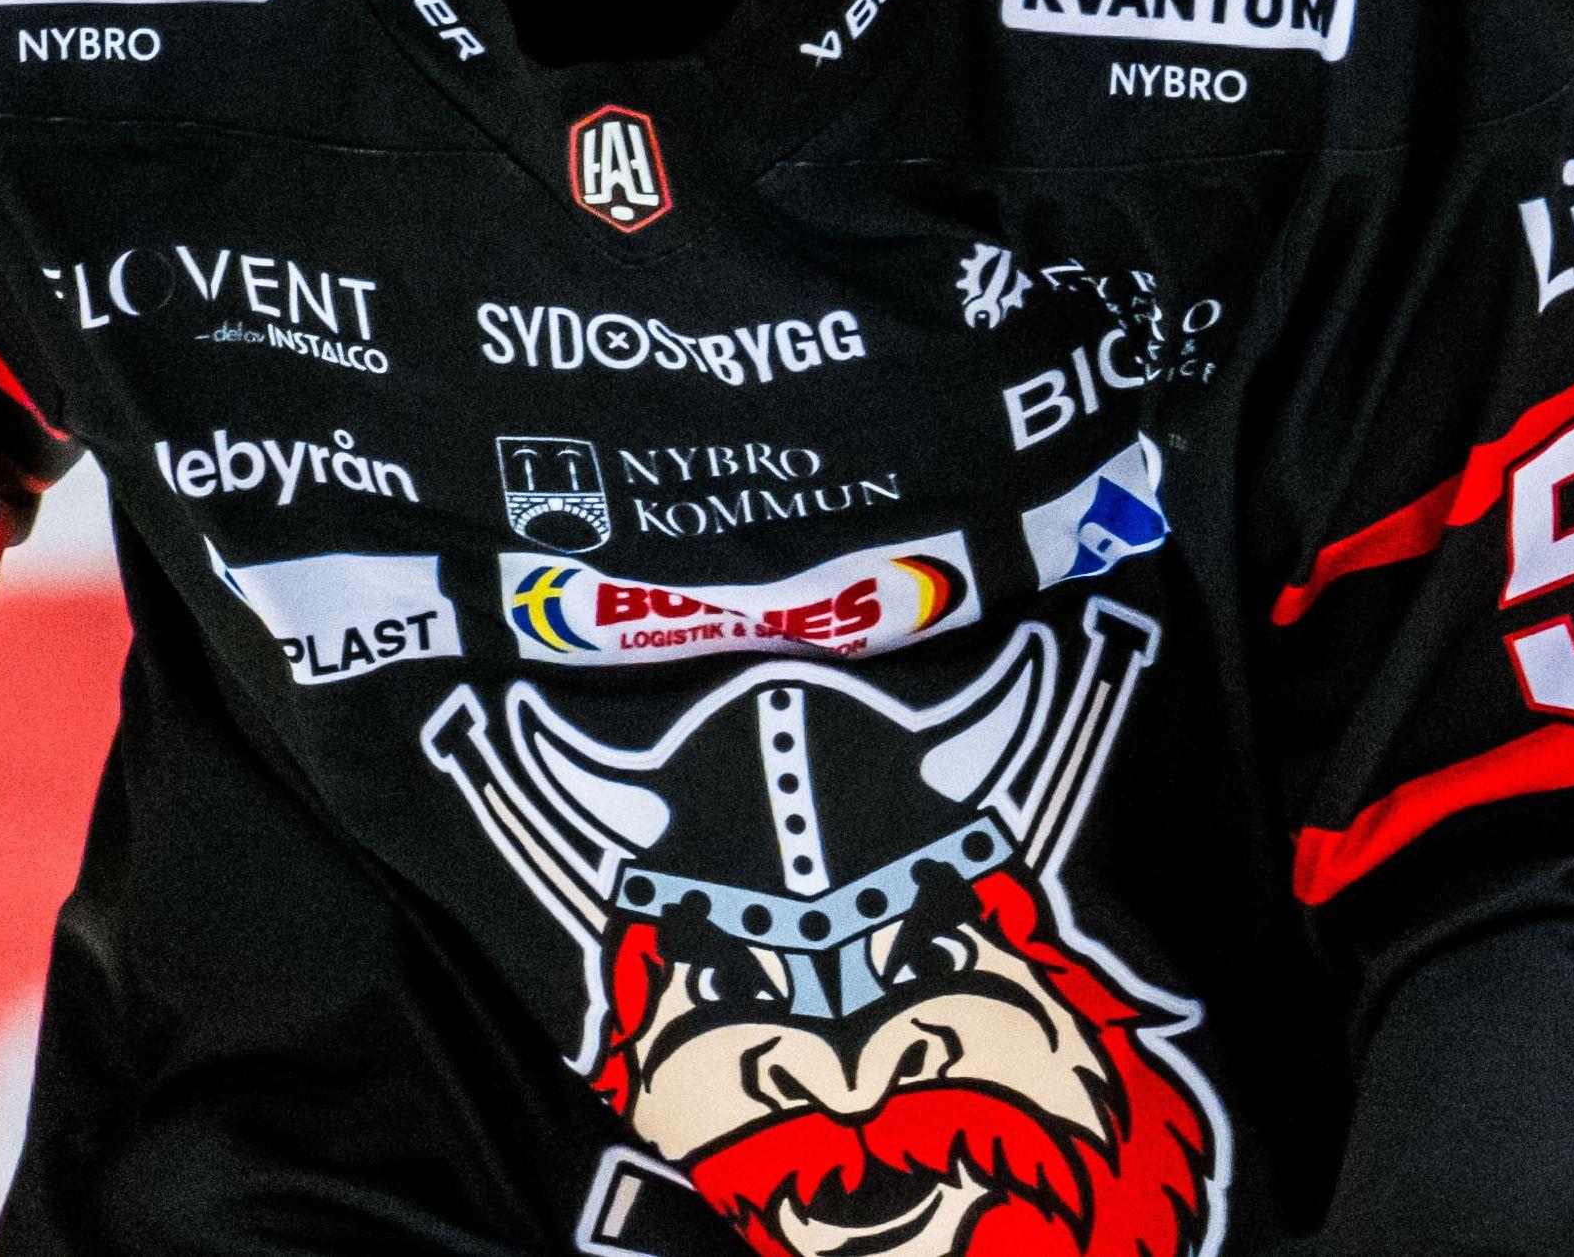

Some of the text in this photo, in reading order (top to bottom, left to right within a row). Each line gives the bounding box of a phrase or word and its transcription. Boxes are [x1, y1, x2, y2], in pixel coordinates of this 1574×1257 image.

[18, 27, 161, 63] NYBRO
[1109, 62, 1249, 103] NYBRO
[267, 323, 389, 374] INSTALCO
[618, 442, 821, 487] NYBRO
[634, 472, 901, 539] KOMMUN
[620, 622, 724, 650] LOGISTIK
